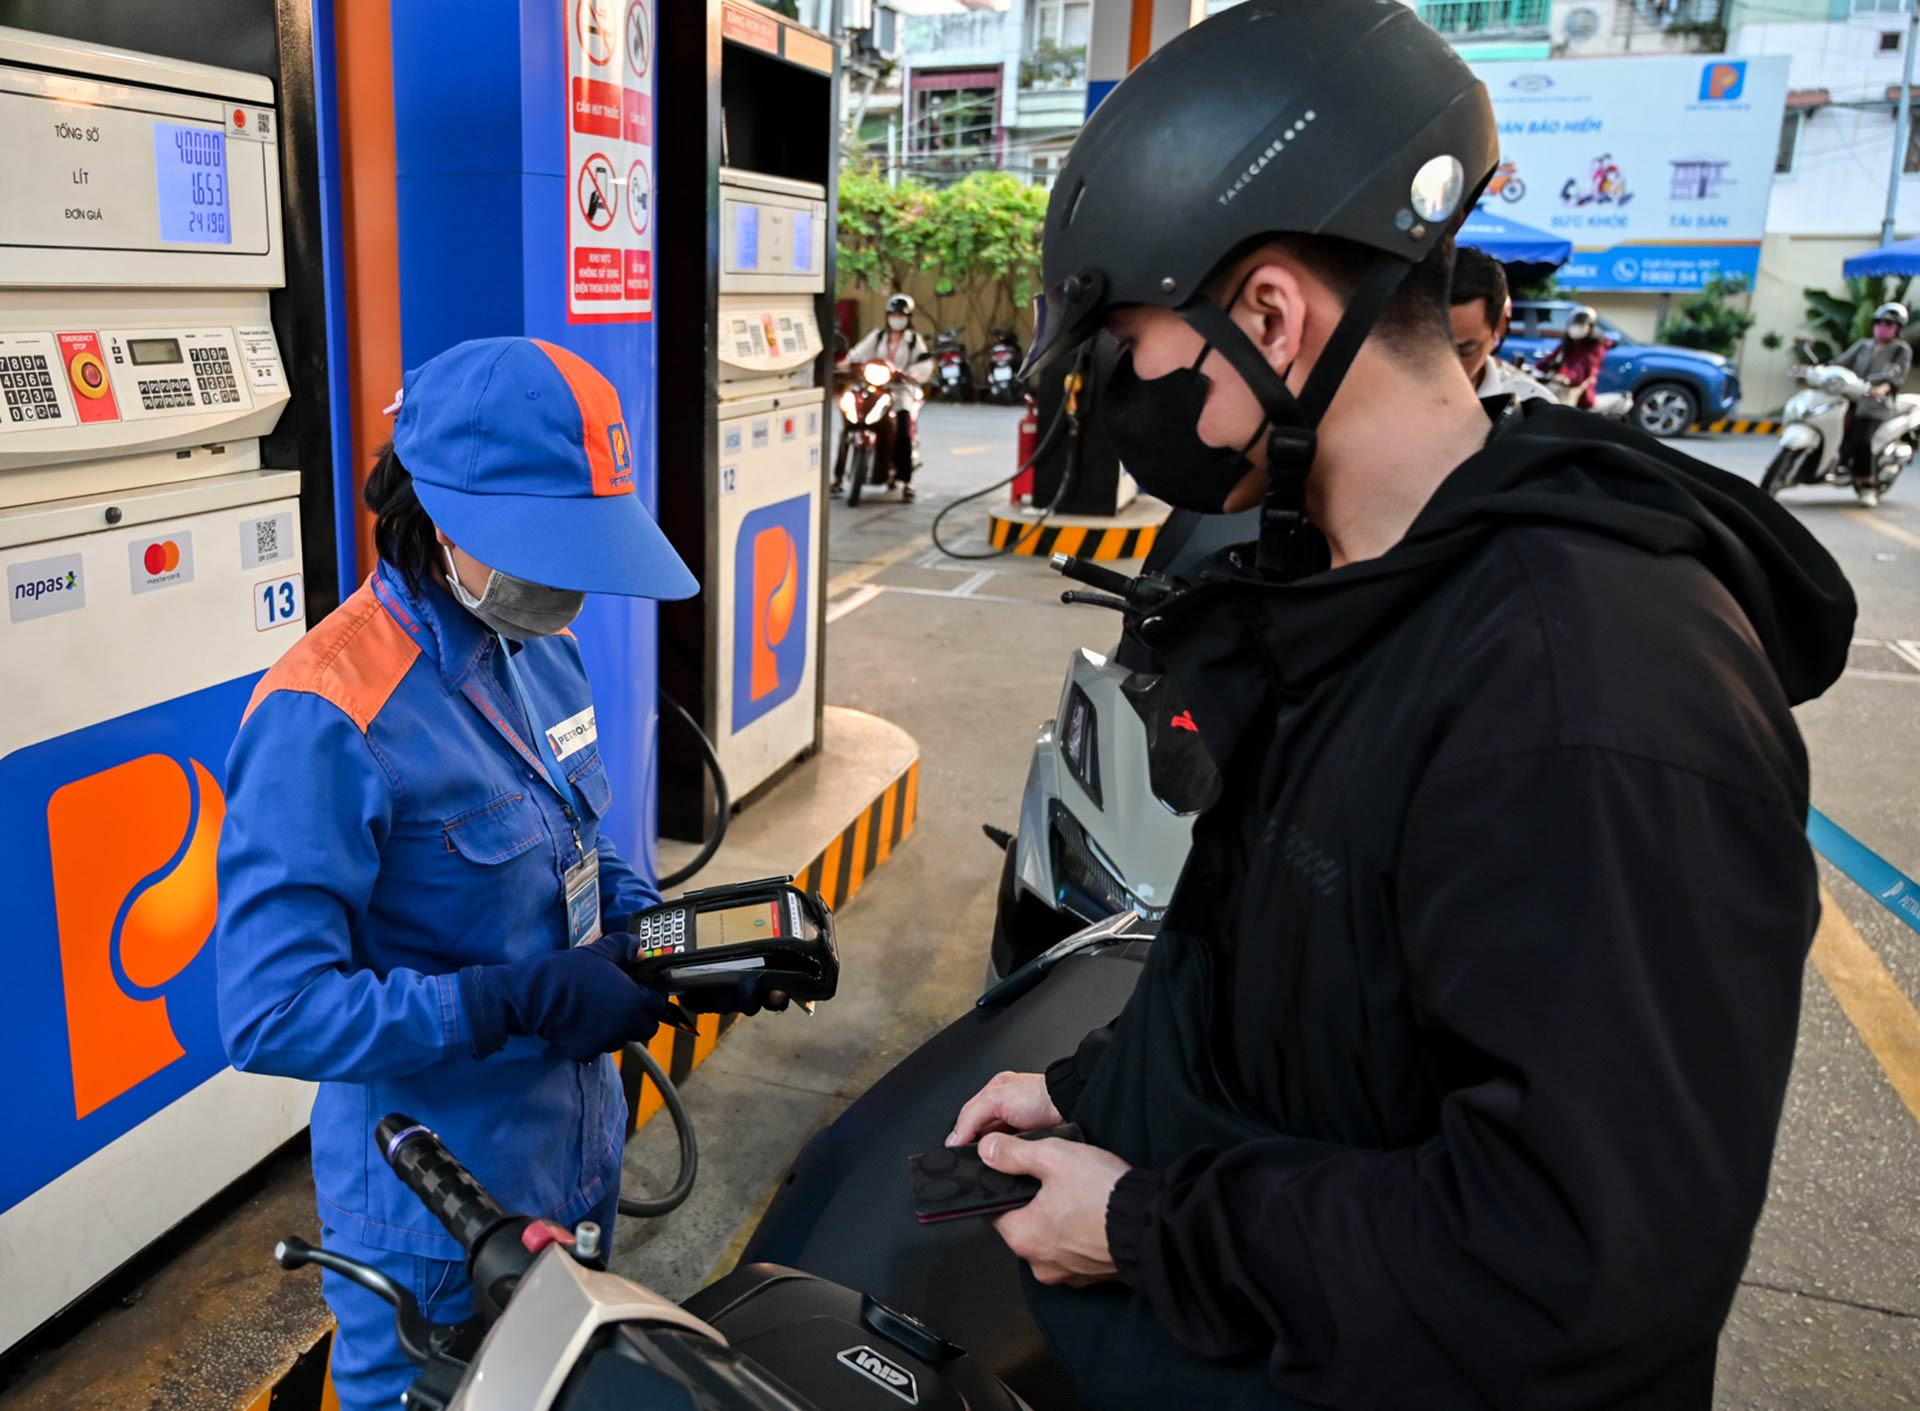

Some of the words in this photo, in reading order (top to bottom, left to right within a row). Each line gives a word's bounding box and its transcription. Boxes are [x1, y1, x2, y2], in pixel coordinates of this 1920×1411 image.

[54, 123, 83, 140] TỔNG
[86, 126, 100, 142] SỐ
[175, 131, 221, 167] 40000
[72, 168, 89, 184] LÍT
[65, 208, 86, 219] ĐƠN
[87, 208, 103, 220] GIÁ
[189, 211, 224, 233] 24190
[61, 334, 94, 342] EMERGENCY
[72, 343, 87, 351] STOP
[11, 358, 19, 369] 8
[24, 358, 32, 369] 9
[4, 375, 11, 386] 4
[16, 375, 24, 386] 5
[29, 374, 36, 385] 6
[20, 391, 29, 402] 2
[33, 390, 41, 401] 3
[12, 408, 20, 420] 0
[25, 408, 33, 419] C
[723, 468, 735, 492] 12
[146, 571, 181, 585] mastercard
[15, 576, 63, 600] napas
[263, 581, 295, 623] 13
[855, 1351, 909, 1385] GIVI
